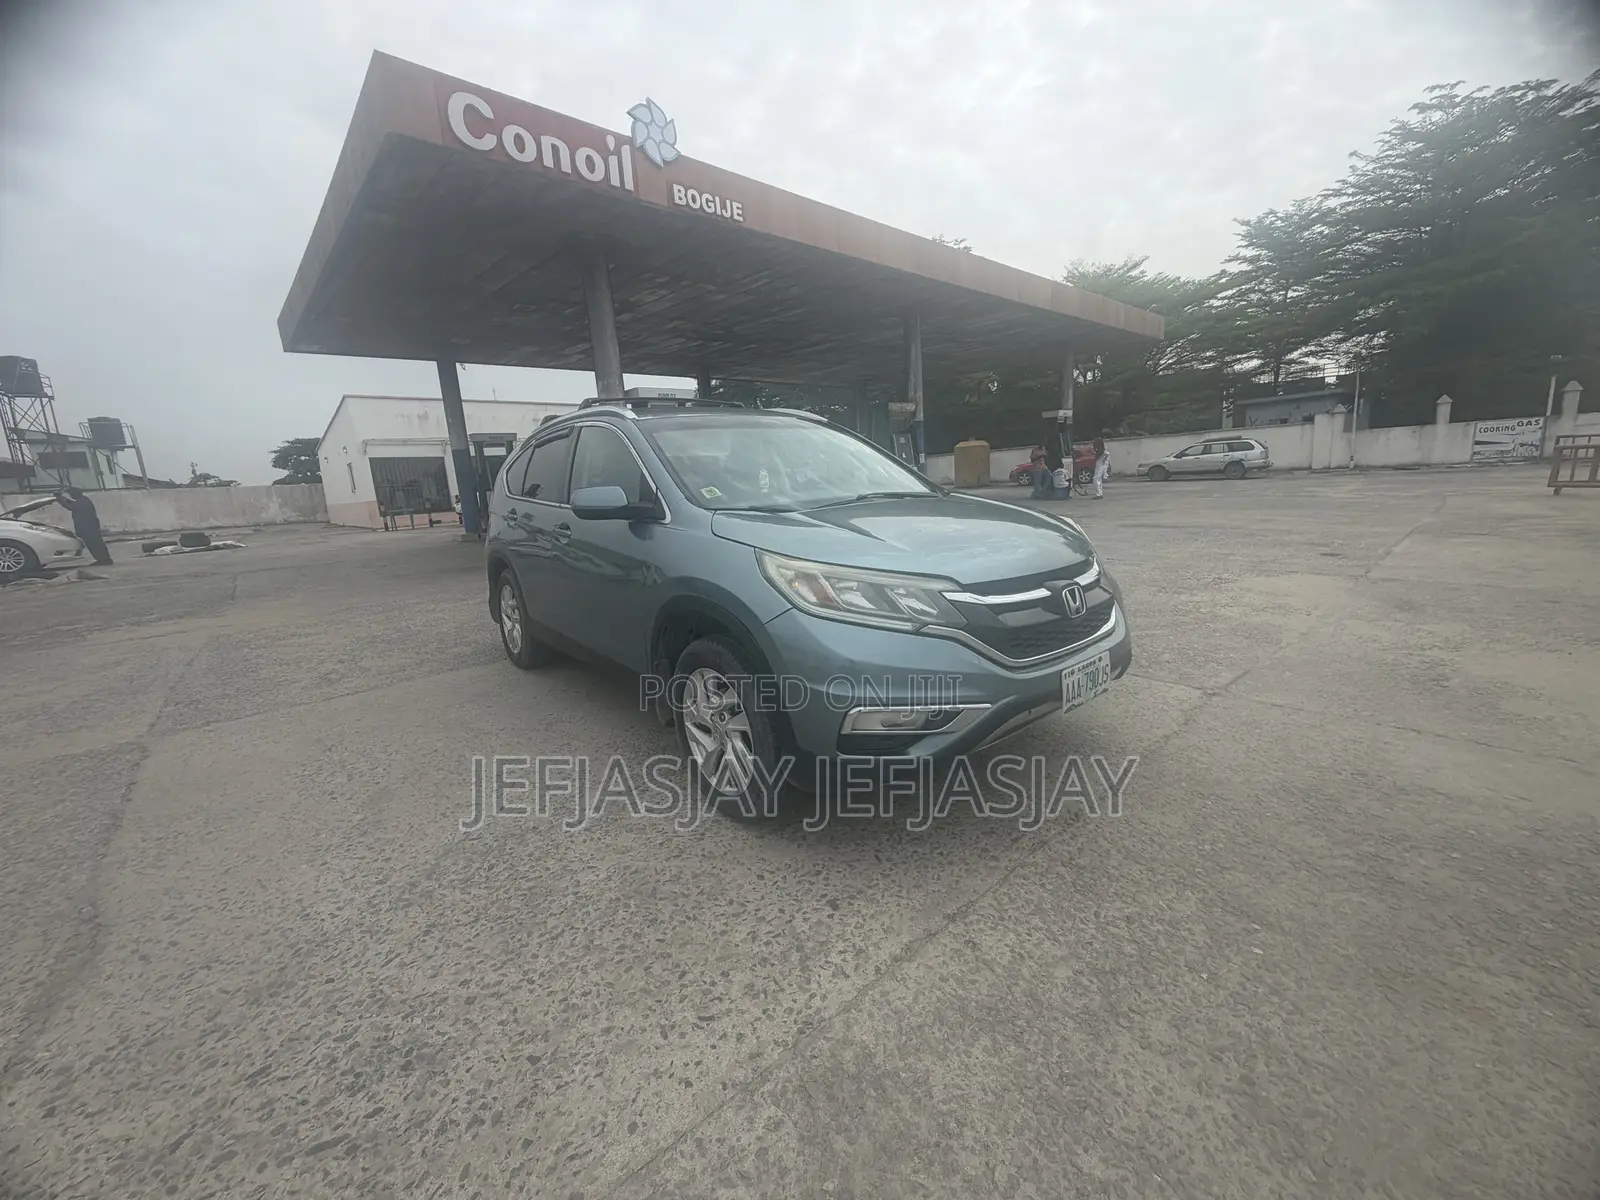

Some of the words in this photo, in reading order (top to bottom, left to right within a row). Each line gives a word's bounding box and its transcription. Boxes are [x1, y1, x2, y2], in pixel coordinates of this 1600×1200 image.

[447, 91, 635, 191] Conoil
[672, 183, 744, 222] BOGIJE
[1478, 424, 1516, 434] COOKING
[1516, 419, 1541, 428] GAS
